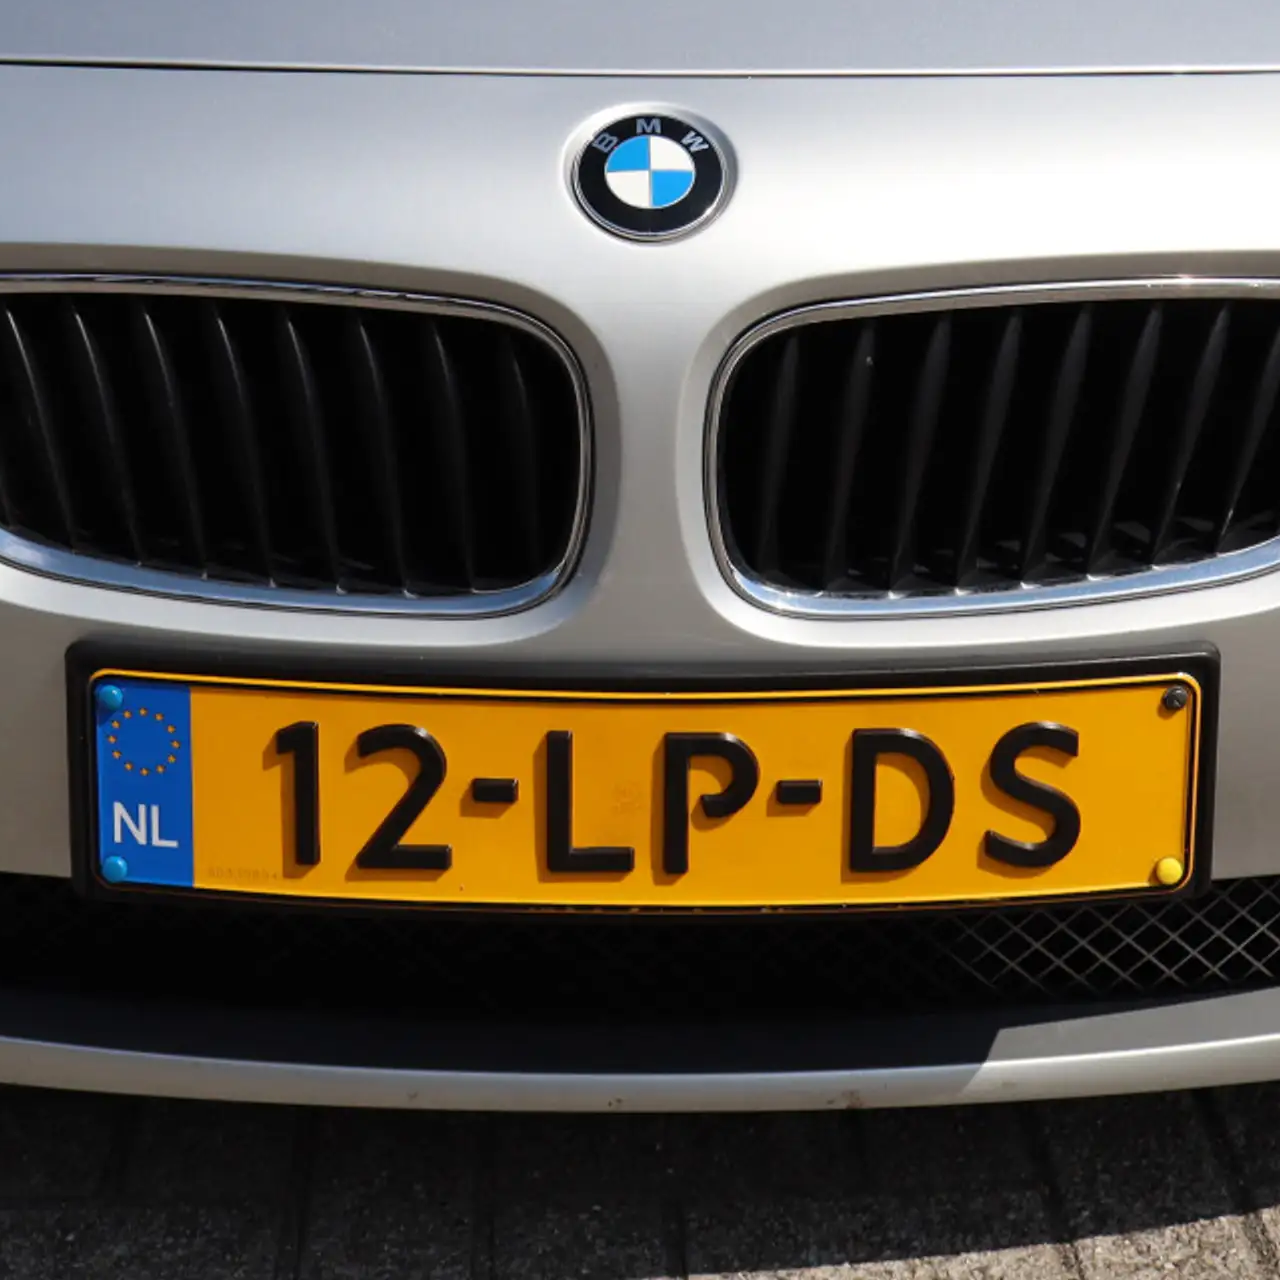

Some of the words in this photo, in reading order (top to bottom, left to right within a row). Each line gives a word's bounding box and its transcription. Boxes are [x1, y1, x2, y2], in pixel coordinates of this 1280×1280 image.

[591, 117, 710, 153] BMW
[275, 720, 1082, 875] 12-LP-DS
[113, 800, 179, 849] NL
